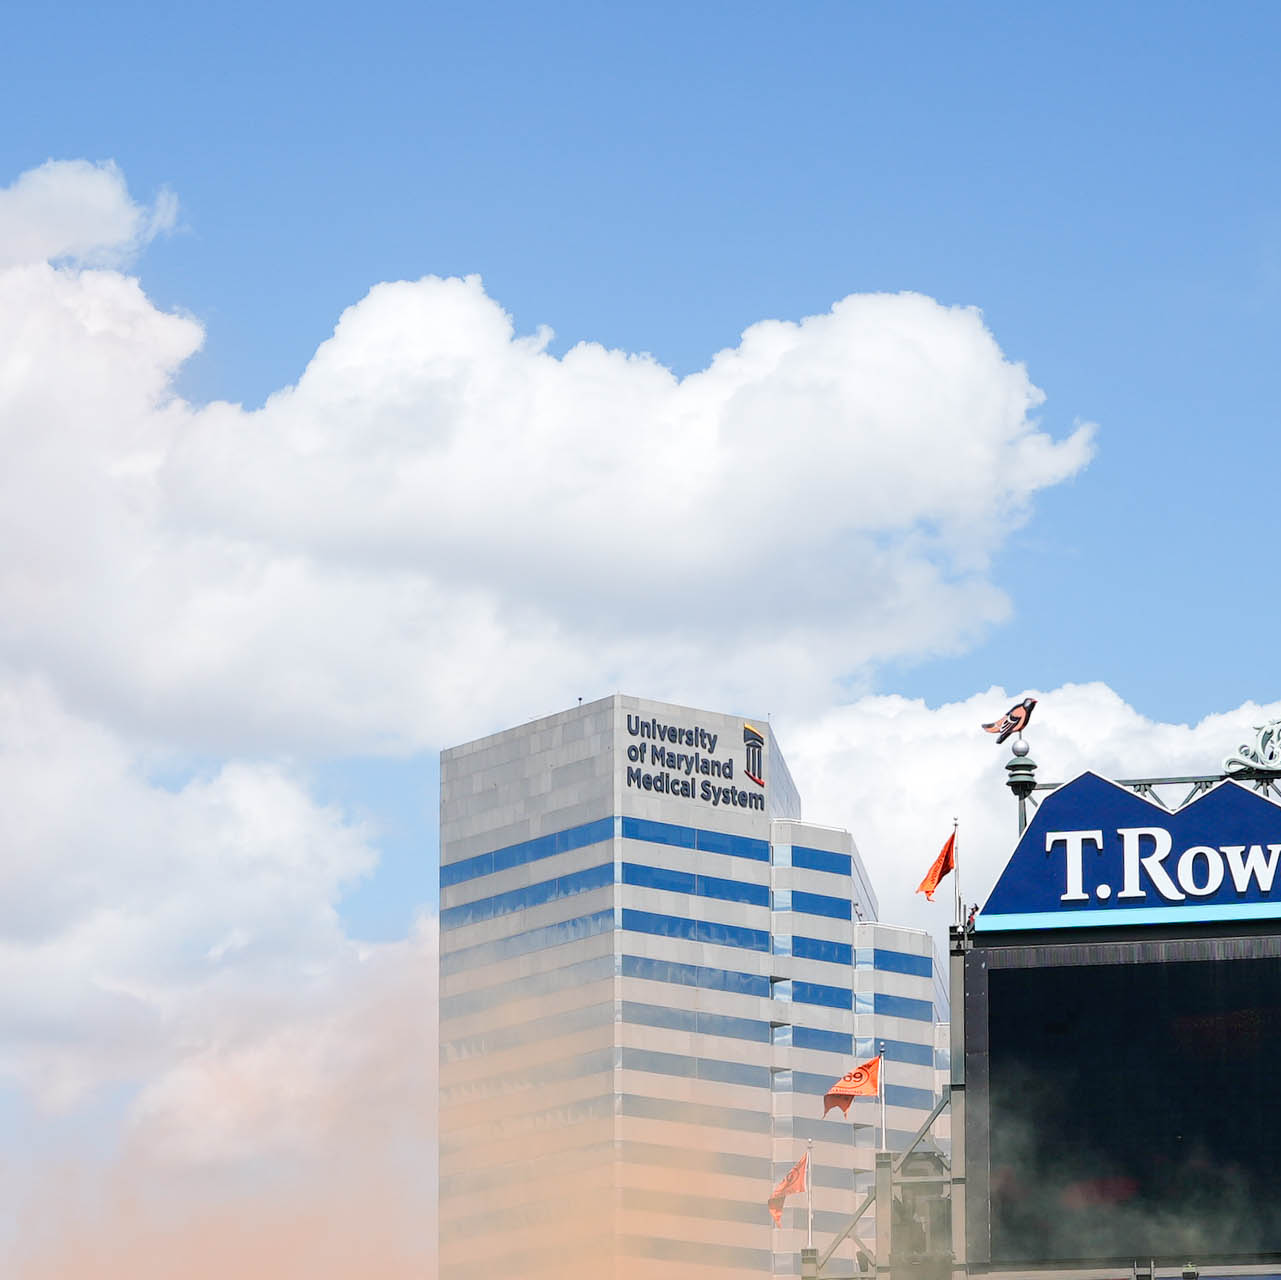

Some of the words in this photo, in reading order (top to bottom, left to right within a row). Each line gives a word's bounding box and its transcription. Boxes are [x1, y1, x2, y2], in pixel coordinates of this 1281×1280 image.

[626, 714, 718, 754] University
[627, 742, 648, 764] of
[651, 744, 734, 781] Maryland
[626, 766, 697, 800] Medical
[700, 779, 766, 812] System
